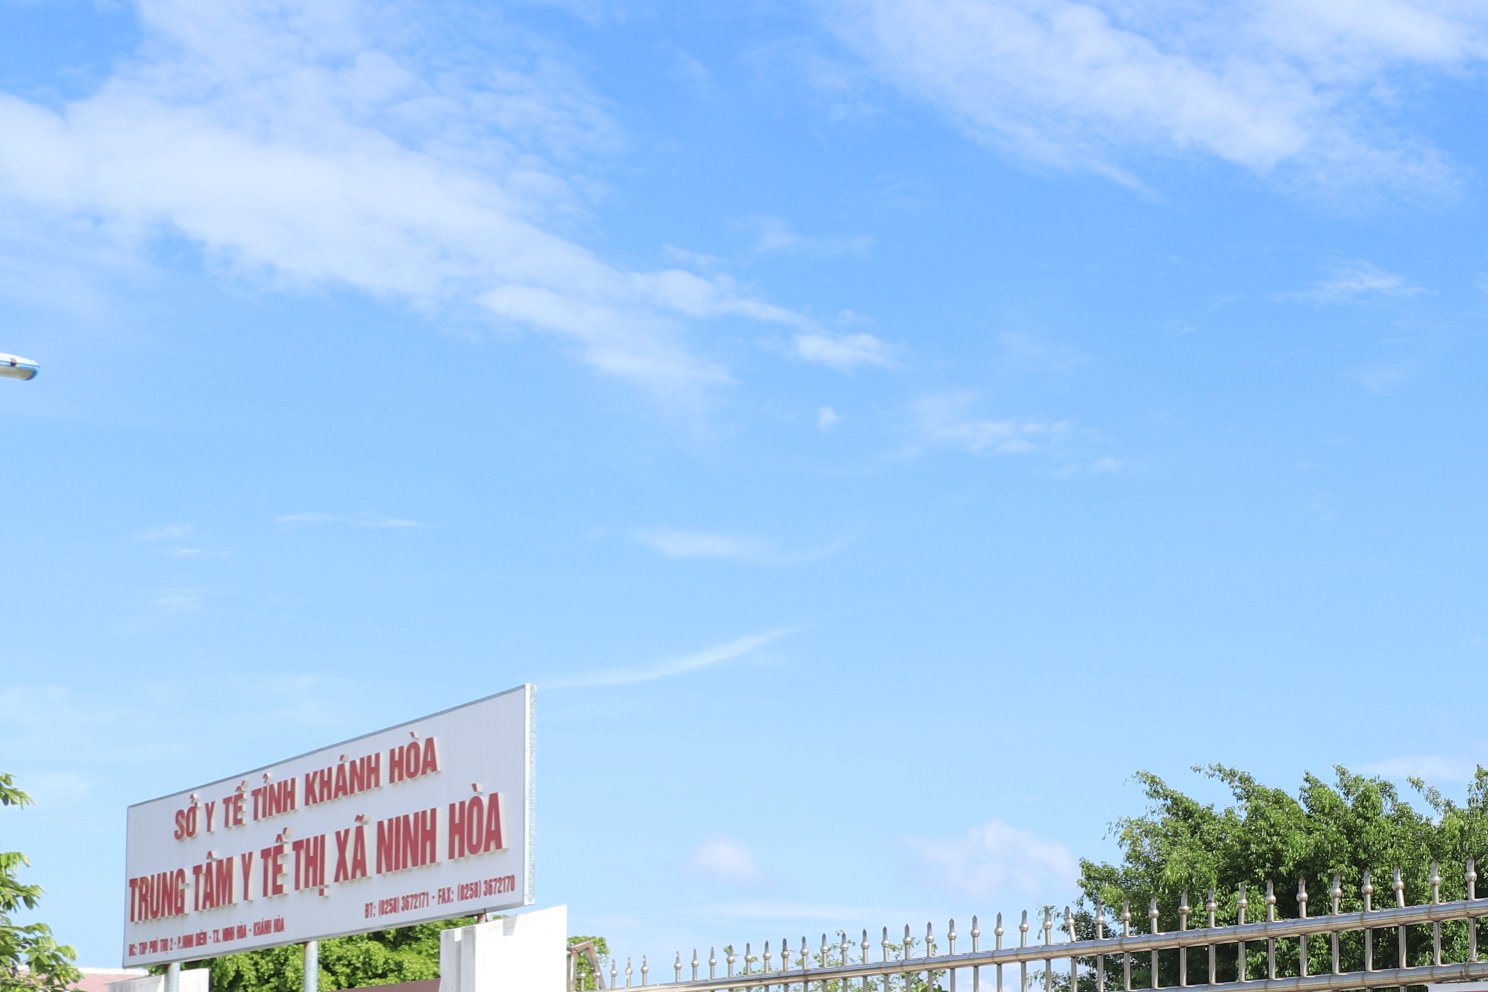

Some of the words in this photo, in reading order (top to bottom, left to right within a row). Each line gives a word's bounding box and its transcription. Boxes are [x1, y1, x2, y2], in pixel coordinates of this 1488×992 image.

[174, 793, 199, 841] SỞ
[205, 801, 217, 832] Y
[222, 780, 248, 828] TẾ
[251, 773, 297, 821] TỈNH
[304, 754, 381, 806] KHÁNH
[389, 731, 439, 784] HÒA
[129, 868, 188, 922] TRUNG
[192, 851, 235, 911] TÂM
[241, 851, 254, 901] Y
[260, 827, 287, 897] TẾ
[292, 834, 327, 897] THỊ
[334, 814, 370, 883] XÃ
[376, 807, 438, 874] NINH
[448, 783, 505, 860] HÒA
[437, 887, 455, 905] FAX:
[457, 880, 481, 902] (0258)
